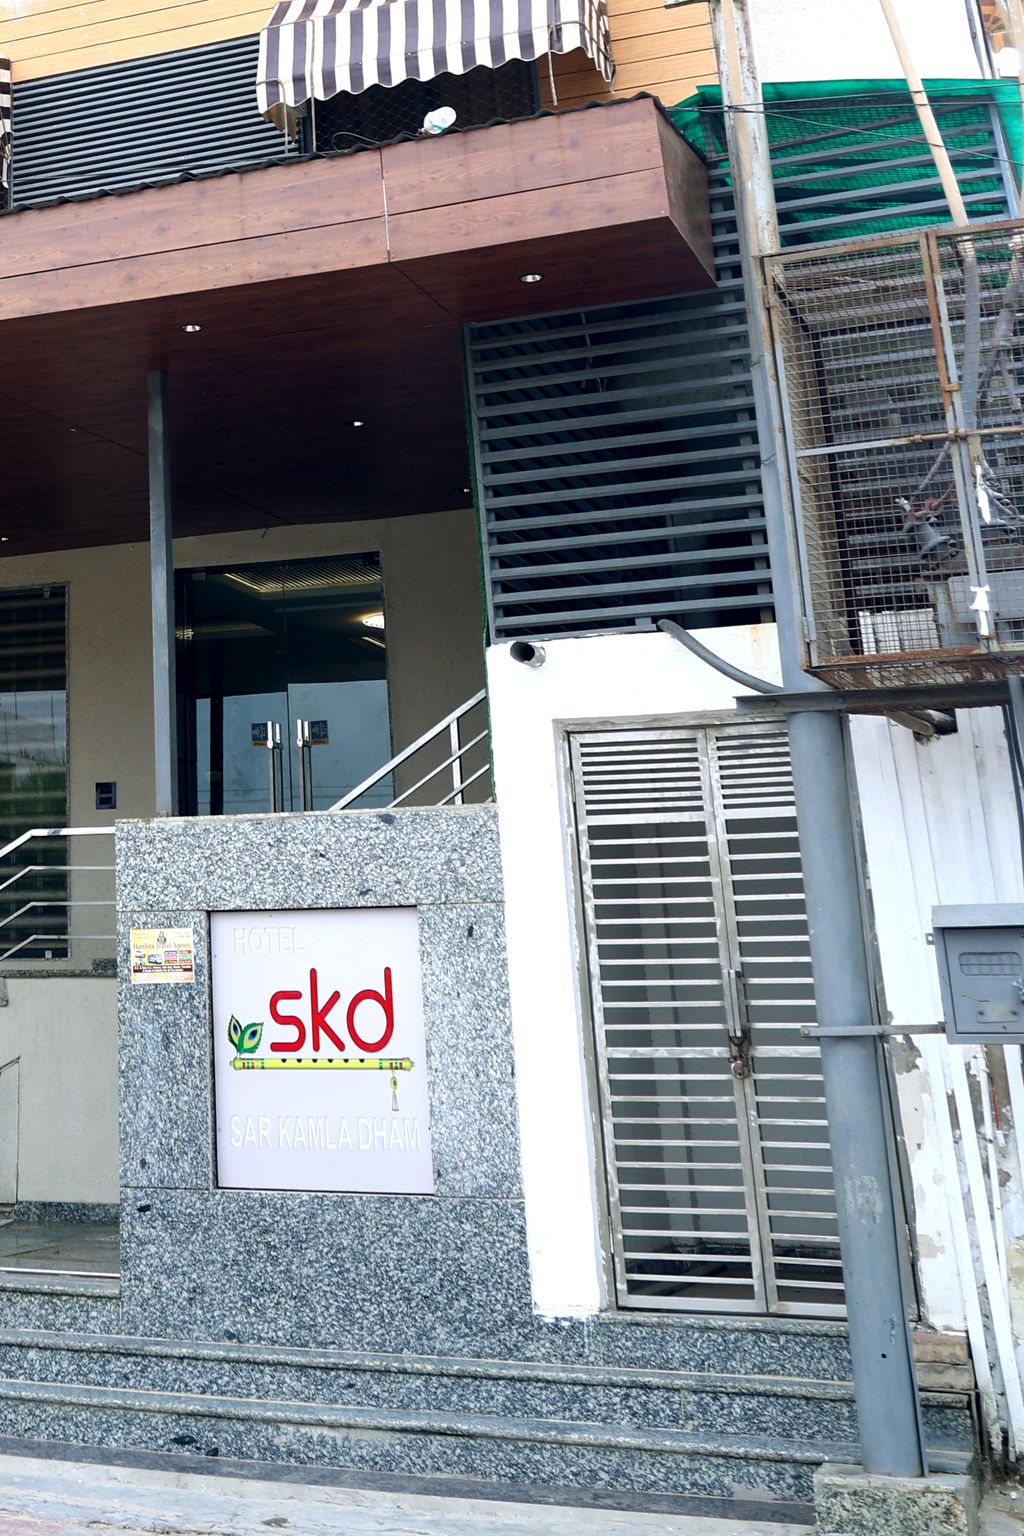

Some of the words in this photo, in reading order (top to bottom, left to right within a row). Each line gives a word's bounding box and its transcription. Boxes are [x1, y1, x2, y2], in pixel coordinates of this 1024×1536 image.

[233, 927, 304, 955] HOTEL
[268, 966, 394, 1053] skd
[230, 1114, 272, 1150] SAR
[278, 1115, 352, 1151] KAMLA
[357, 1116, 422, 1152] DHAM
